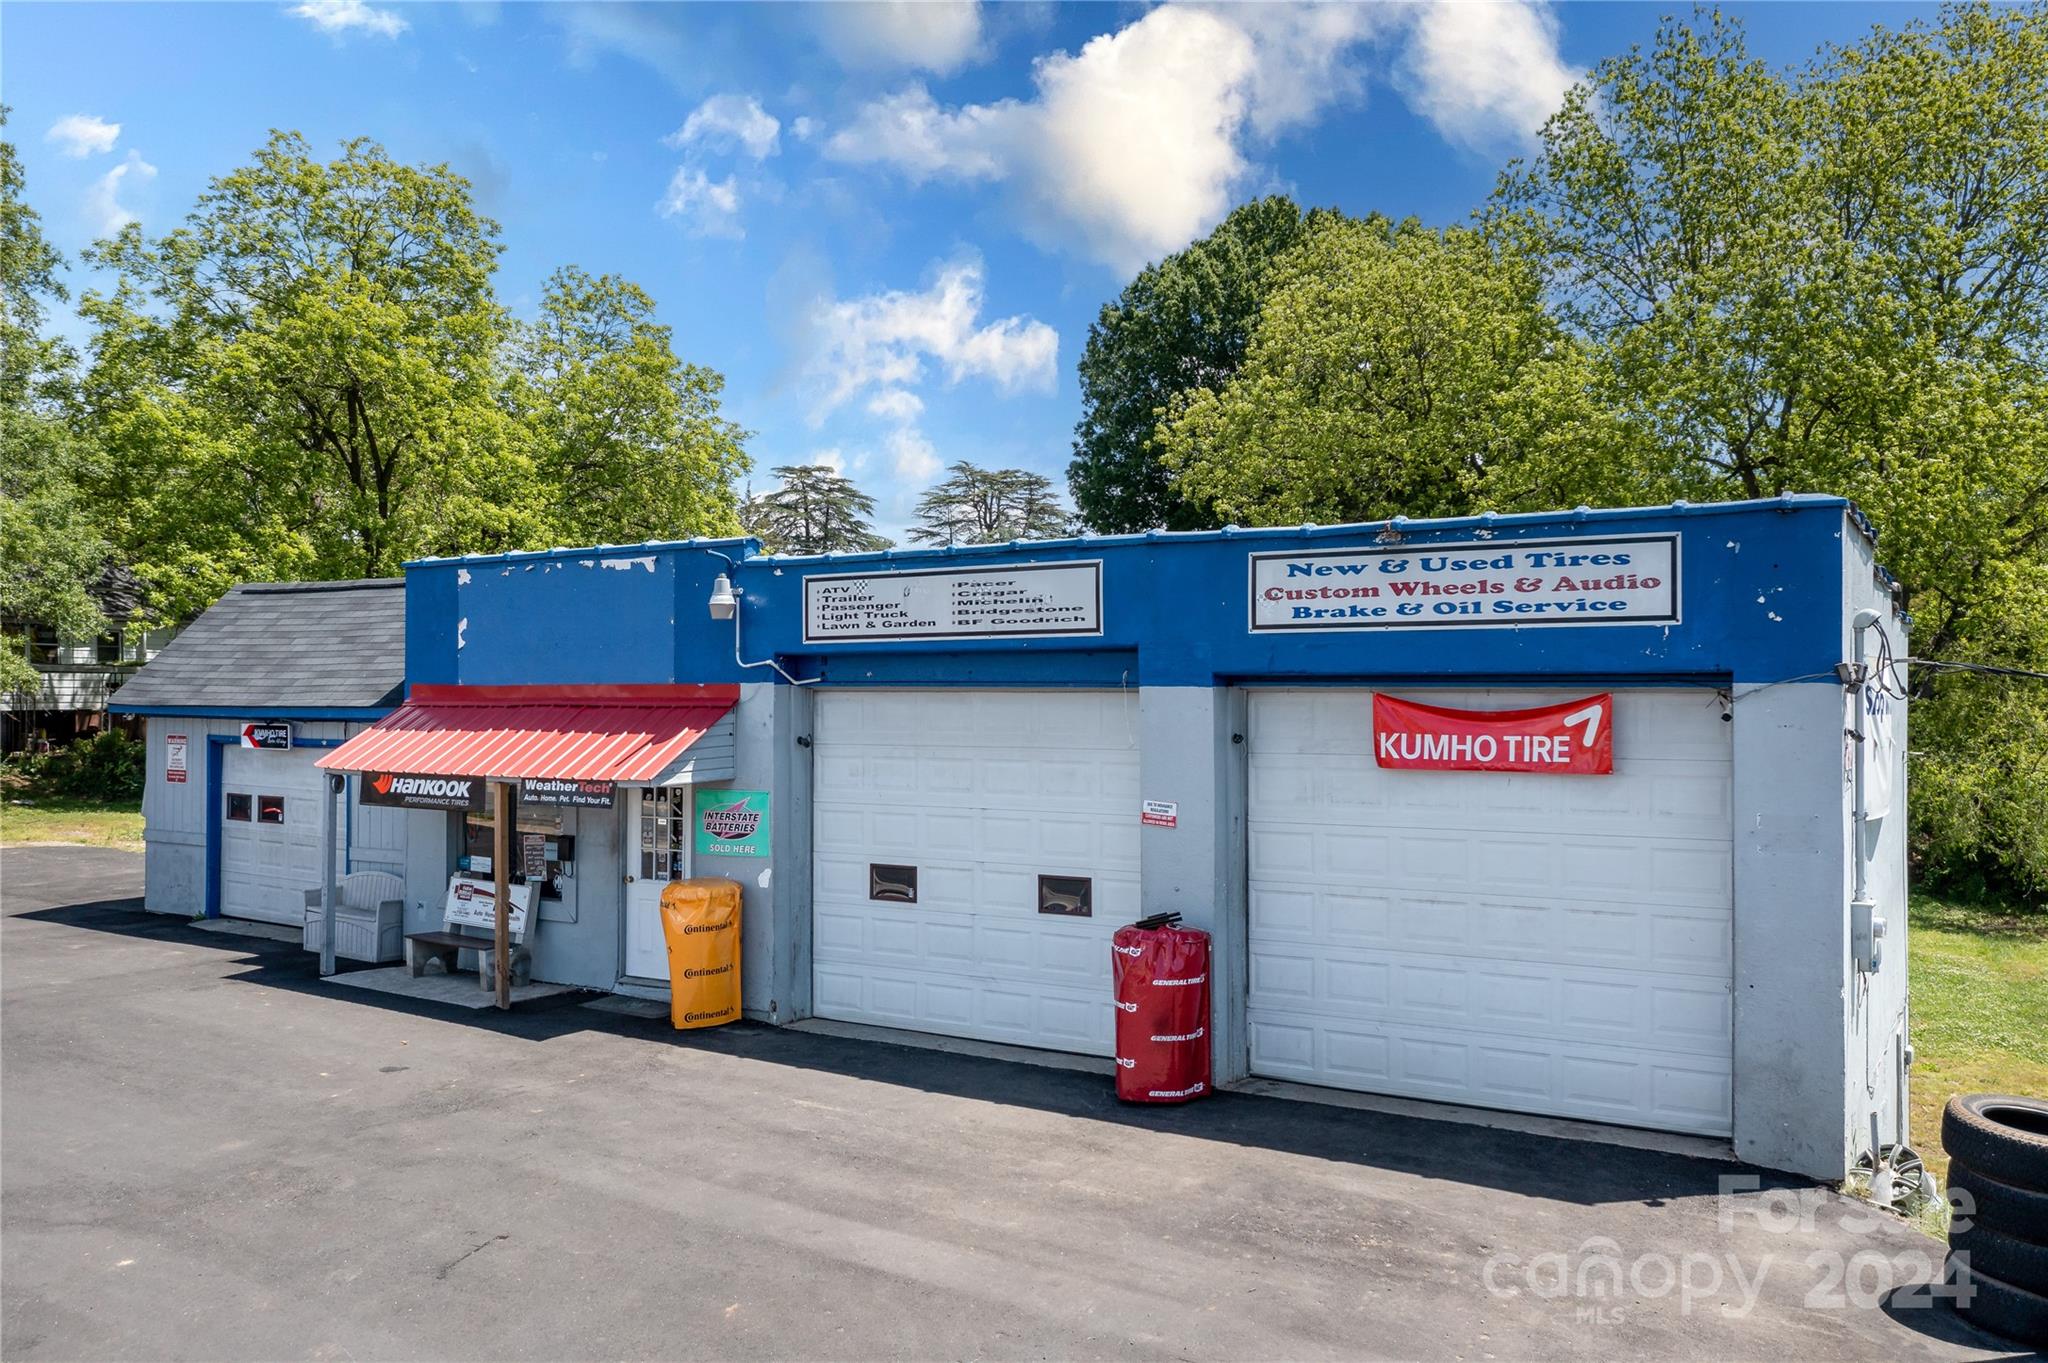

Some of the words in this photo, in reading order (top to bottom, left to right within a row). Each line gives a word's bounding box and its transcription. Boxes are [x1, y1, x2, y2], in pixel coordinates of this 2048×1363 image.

[1287, 563, 1368, 577] New
[1378, 559, 1409, 574] &
[1420, 555, 1514, 572] Used
[1524, 552, 1631, 568] Tires
[957, 580, 1016, 588] Pacer
[1264, 586, 1380, 601] Custom
[1388, 579, 1505, 597] Wheels
[1514, 577, 1543, 593] &
[1551, 574, 1661, 592] Audio
[822, 586, 850, 594] ATV
[957, 589, 1027, 597] Cragar
[822, 594, 875, 603] Trailer
[957, 597, 1043, 606] Michelin
[821, 602, 901, 611] Passenger
[957, 606, 1084, 615] Bridgestone
[1291, 605, 1387, 619] Brake
[1396, 602, 1424, 616] &
[1433, 600, 1482, 615] Oil
[1492, 598, 1627, 613] Service
[821, 612, 859, 621] Light
[864, 610, 908, 619] Truck
[991, 615, 1086, 624] Goodrich
[821, 622, 860, 630] Lawn
[865, 621, 876, 629] &
[882, 619, 936, 628] Garden
[1380, 732, 1497, 762] KUMHO
[1503, 735, 1571, 763] TIRE
[525, 779, 611, 793] WeatherTech
[404, 796, 450, 806] PERFORMANCE
[587, 796, 600, 804] Your
[704, 811, 759, 822] INTERSTATE
[705, 822, 756, 832] BATTERIES
[710, 844, 731, 852] SOLD
[733, 845, 755, 854] HERE
[683, 921, 728, 935] Continental
[683, 964, 729, 979] Continental
[684, 1007, 730, 1023] Continental
[1150, 1034, 1186, 1042] GENERAL
